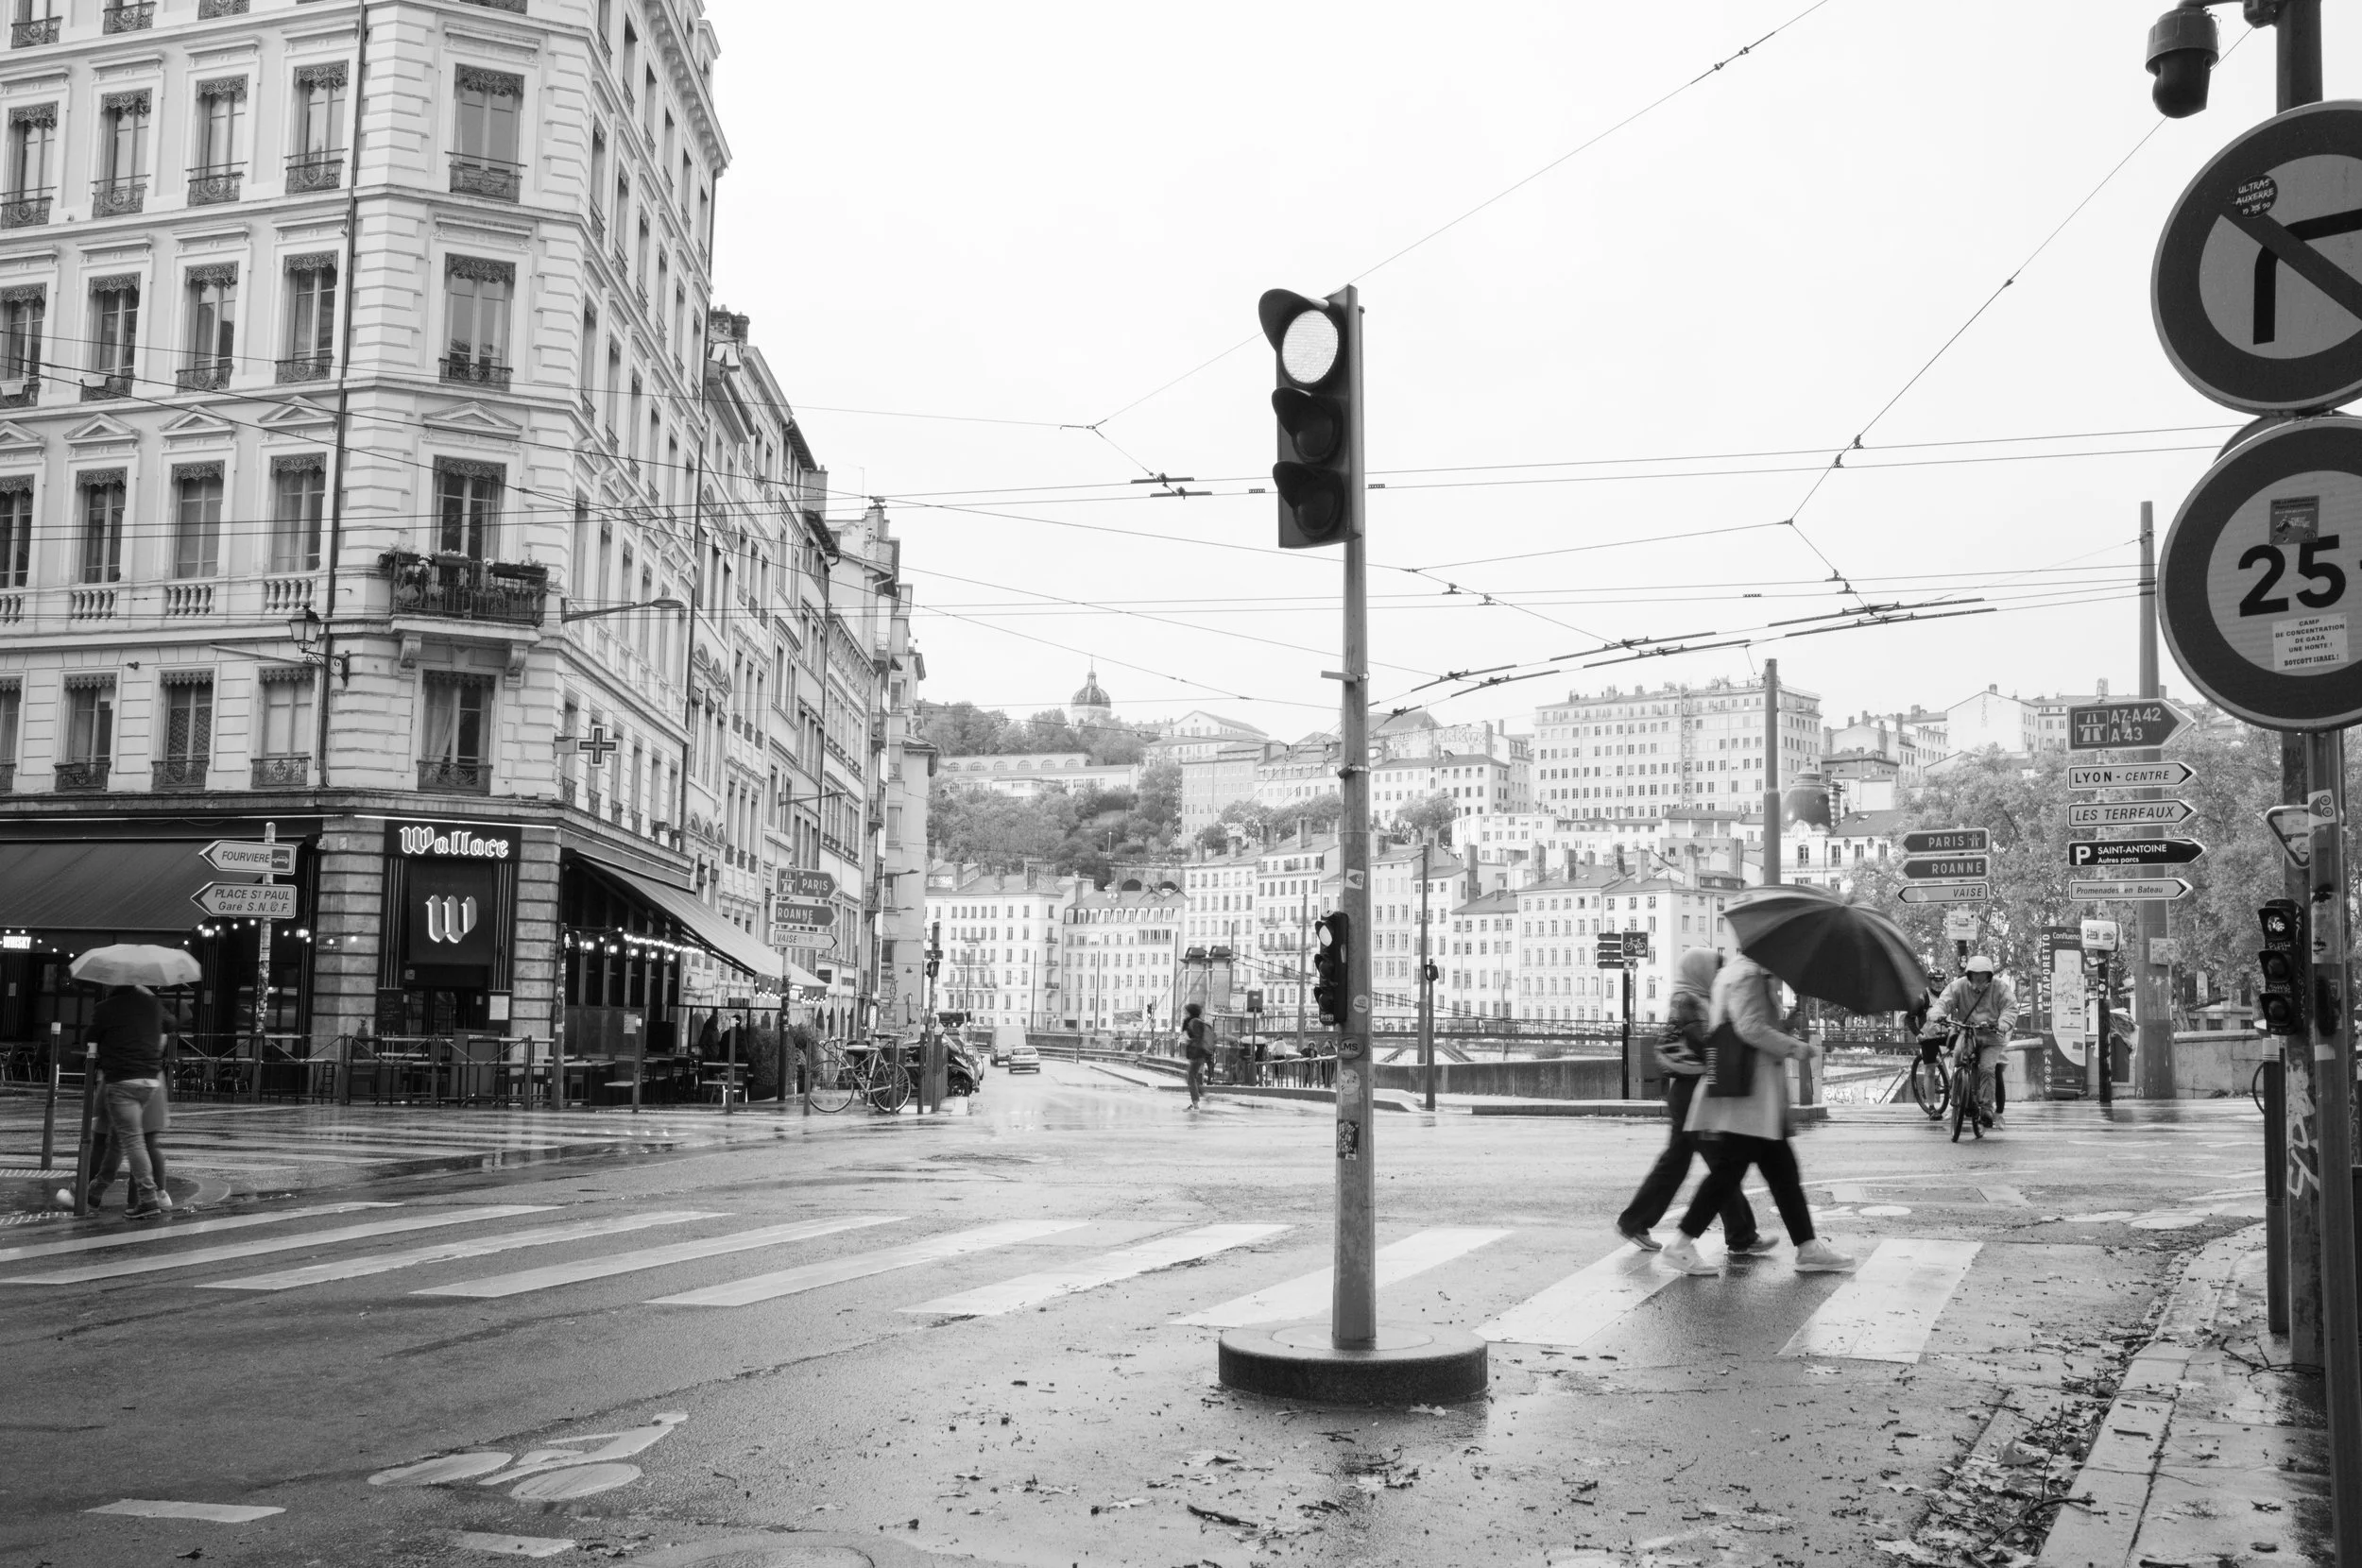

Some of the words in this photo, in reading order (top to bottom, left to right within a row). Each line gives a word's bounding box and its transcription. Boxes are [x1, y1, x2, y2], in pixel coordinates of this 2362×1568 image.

[2238, 179, 2269, 194] ULTRAS
[2235, 188, 2275, 206] AUXERRE
[2299, 619, 2319, 627] CAMP
[2285, 623, 2345, 637] CONCENTRATION
[2305, 634, 2326, 642] GAZA
[2284, 656, 2313, 667] BOYCOTT
[2313, 654, 2336, 663] ISRAEL
[2111, 707, 2162, 724] A7-A42
[2075, 771, 2113, 784] LYON
[2125, 770, 2170, 782] CENTRE
[2075, 809, 2098, 822] LES
[2104, 806, 2175, 820] TERREAUX
[399, 826, 509, 859] Wallace
[1928, 835, 1964, 848] PARIS
[221, 850, 271, 863] FOURVIERE
[2097, 844, 2167, 856] SAINT-ANTOINE
[2097, 856, 2119, 864] Autres
[2120, 856, 2140, 865] parcs
[1931, 861, 1982, 876] ROANNE
[801, 878, 829, 891] PARIS
[2076, 886, 2119, 895] Promenades
[2137, 885, 2164, 895] Bateau
[214, 888, 248, 899] PLACE
[264, 890, 290, 901] PAUL
[1952, 887, 1983, 898] VAISE
[218, 901, 243, 912] Gare
[777, 907, 813, 921] ROANNE
[777, 933, 797, 944] VAISE
[2052, 931, 2081, 941] Confluenc
[2043, 1000, 2051, 1014] LE
